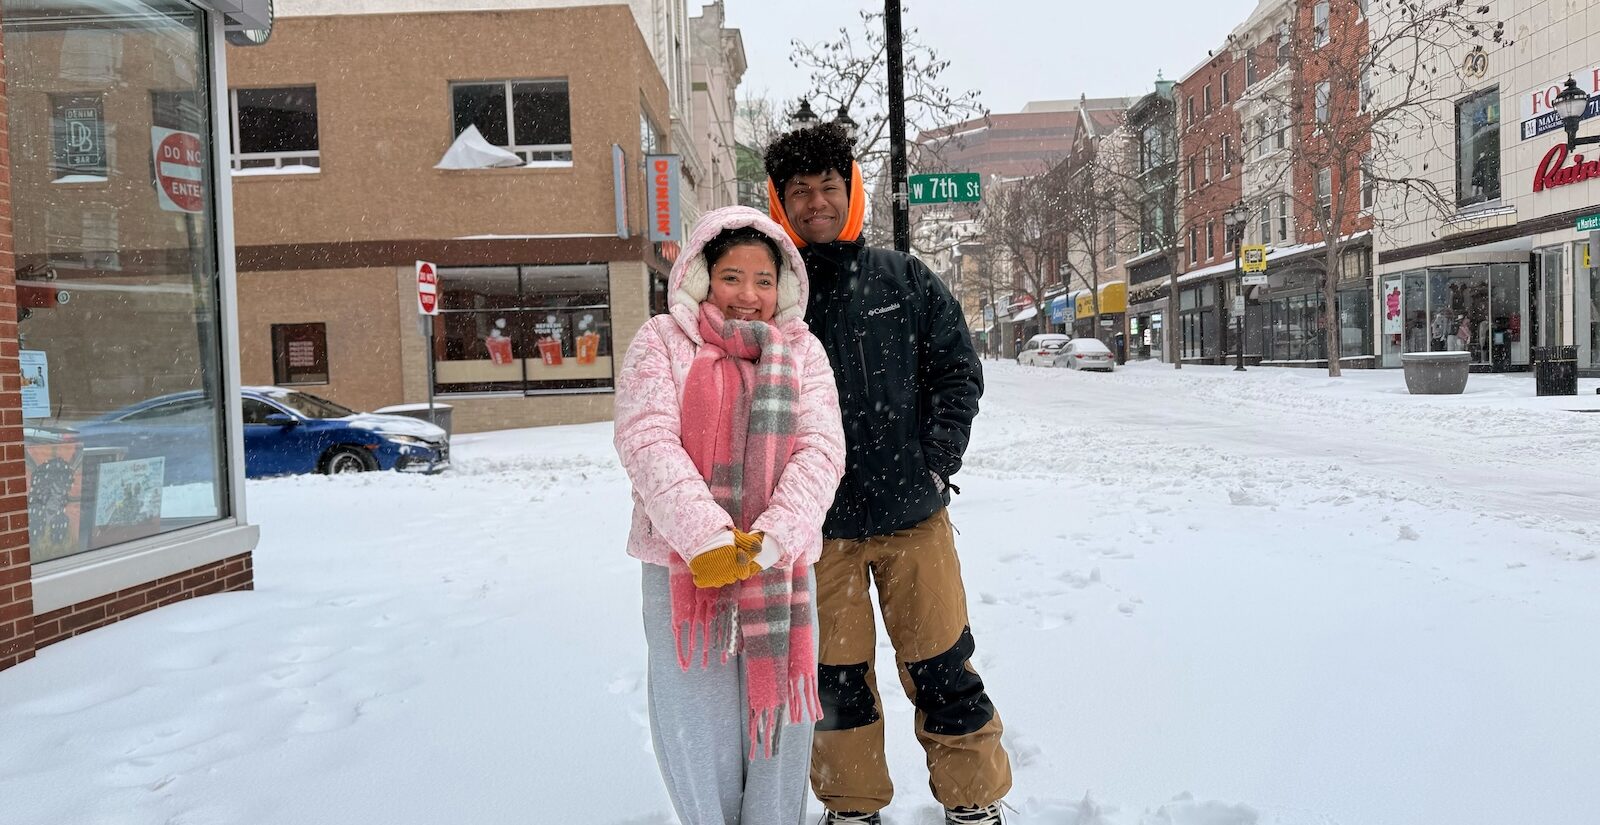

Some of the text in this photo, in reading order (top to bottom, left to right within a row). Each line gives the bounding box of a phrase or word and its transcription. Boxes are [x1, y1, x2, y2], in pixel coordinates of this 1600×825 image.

[1531, 85, 1561, 115] FO
[67, 110, 94, 118] DENIM
[1538, 113, 1562, 127] MAVE
[1538, 120, 1565, 132] MANAGEME
[164, 145, 201, 163] DO NO
[1533, 143, 1600, 192] Rain
[913, 177, 980, 199] W 7th St
